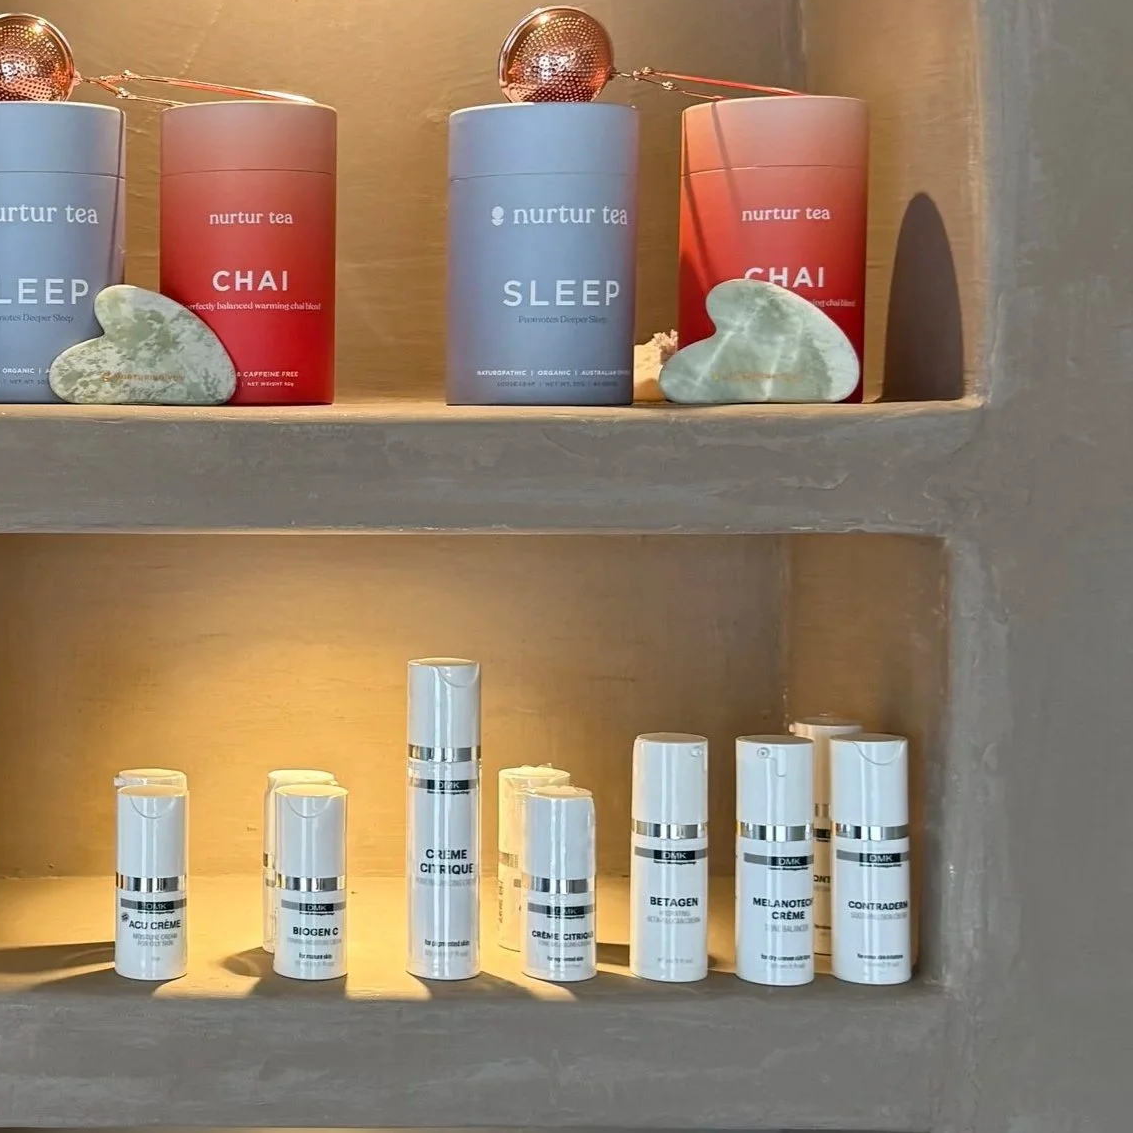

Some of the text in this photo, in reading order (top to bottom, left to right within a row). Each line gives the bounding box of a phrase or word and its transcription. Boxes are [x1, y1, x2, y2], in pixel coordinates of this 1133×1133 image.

[65, 205, 99, 224] tea
[209, 212, 293, 225] nurtur tea
[513, 205, 627, 225] nurtur tea
[742, 208, 830, 221] nurtur tea
[212, 270, 288, 292] CHAI
[744, 266, 824, 288] CHAI
[502, 280, 620, 307] SLEEP
[188, 302, 215, 312] erfectly
[216, 301, 253, 310] balanced
[254, 302, 289, 311] warming
[778, 857, 800, 865] DMK
[650, 897, 698, 907] BETAGEN
[129, 920, 148, 929] ACU
[293, 927, 338, 936] BIOGEN C
